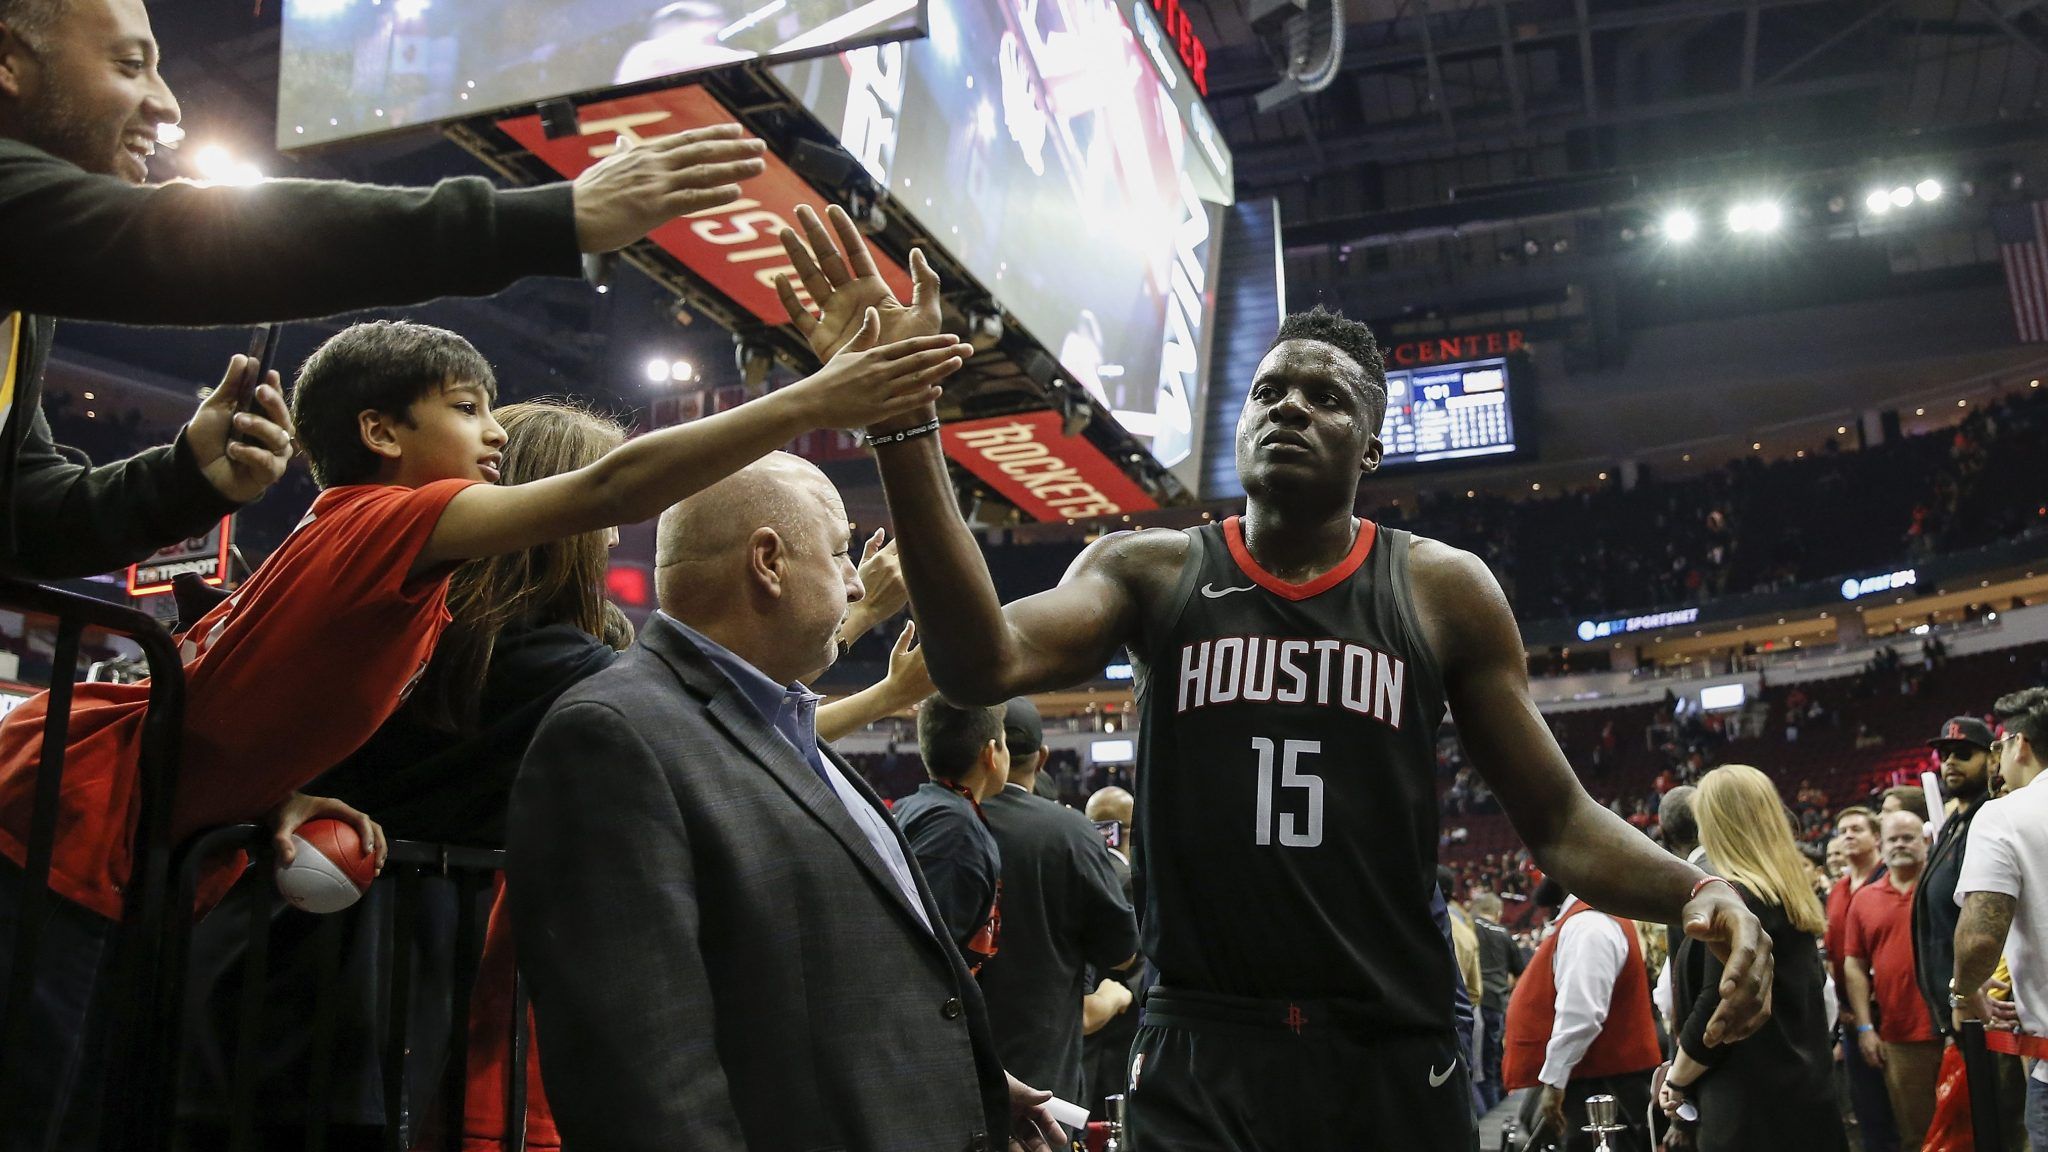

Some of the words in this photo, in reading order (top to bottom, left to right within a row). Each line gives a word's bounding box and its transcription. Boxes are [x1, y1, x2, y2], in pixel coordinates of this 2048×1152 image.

[1154, 0, 1209, 97] TER
[1395, 329, 1526, 365] CENTER
[954, 421, 1121, 519] ROCKETS
[1625, 607, 1699, 632] SPORTSNET
[1177, 636, 1406, 729] HOUSTON
[1251, 736, 1324, 848] 15
